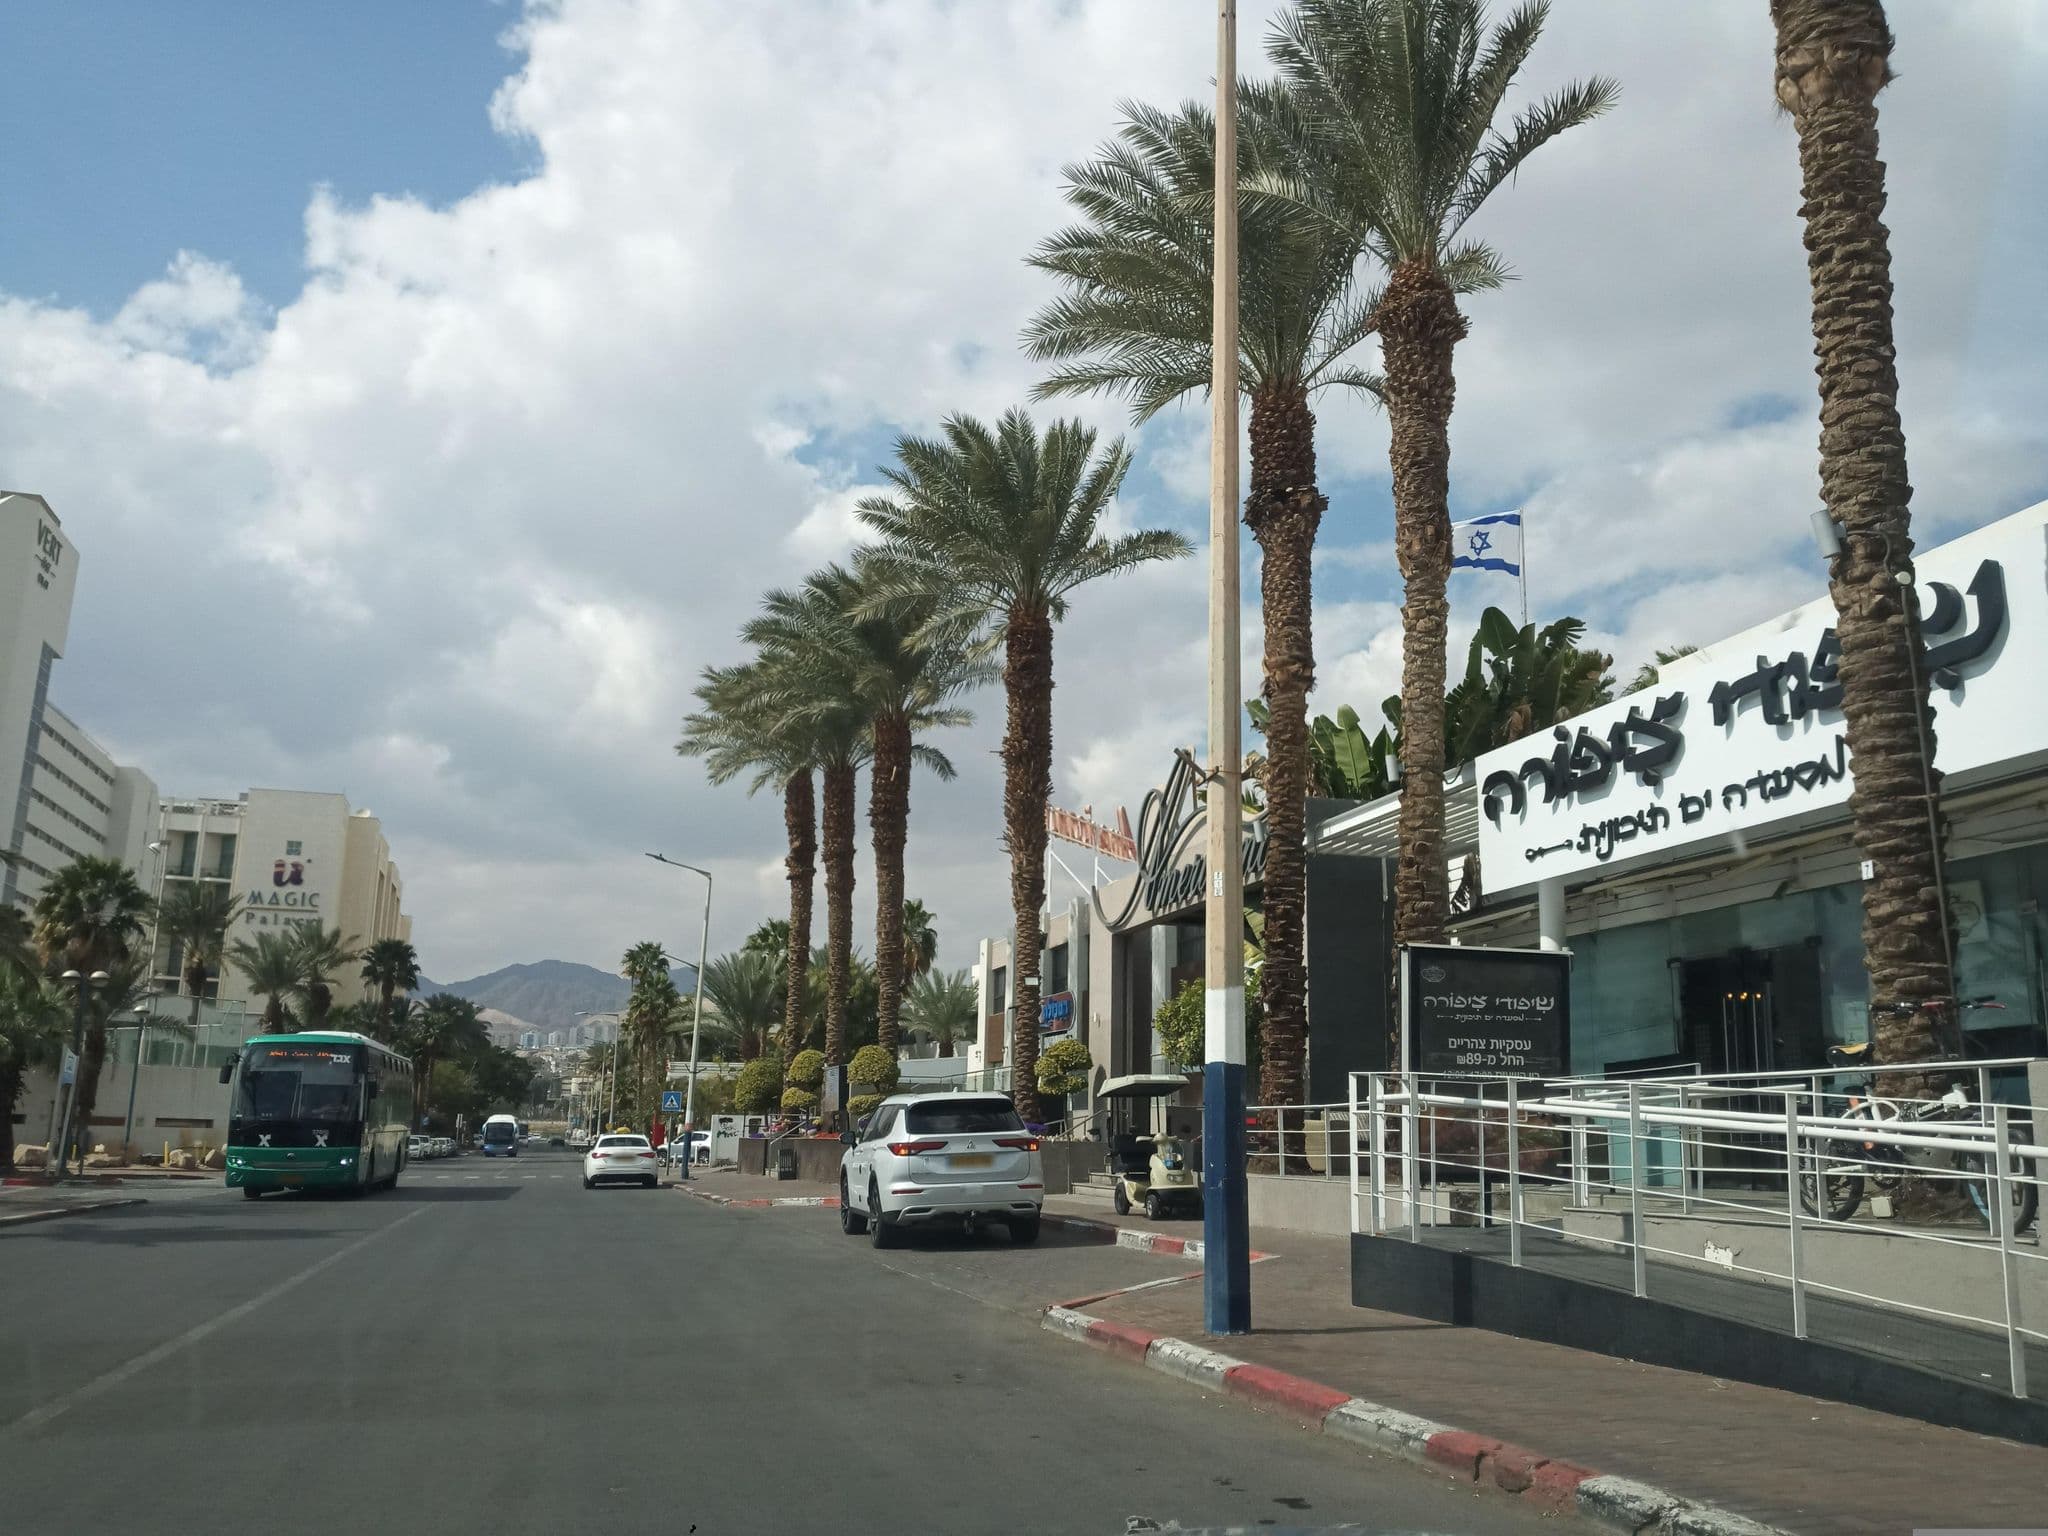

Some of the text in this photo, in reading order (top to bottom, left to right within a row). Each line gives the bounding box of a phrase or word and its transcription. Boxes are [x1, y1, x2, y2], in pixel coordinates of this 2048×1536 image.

[37, 518, 63, 566] VERT
[247, 890, 320, 907] MAGIC
[1423, 992, 1488, 1012] ציפורה
[1448, 1038, 1532, 1053] עסקיות צהריים
[1500, 1051, 1525, 1066] החל
